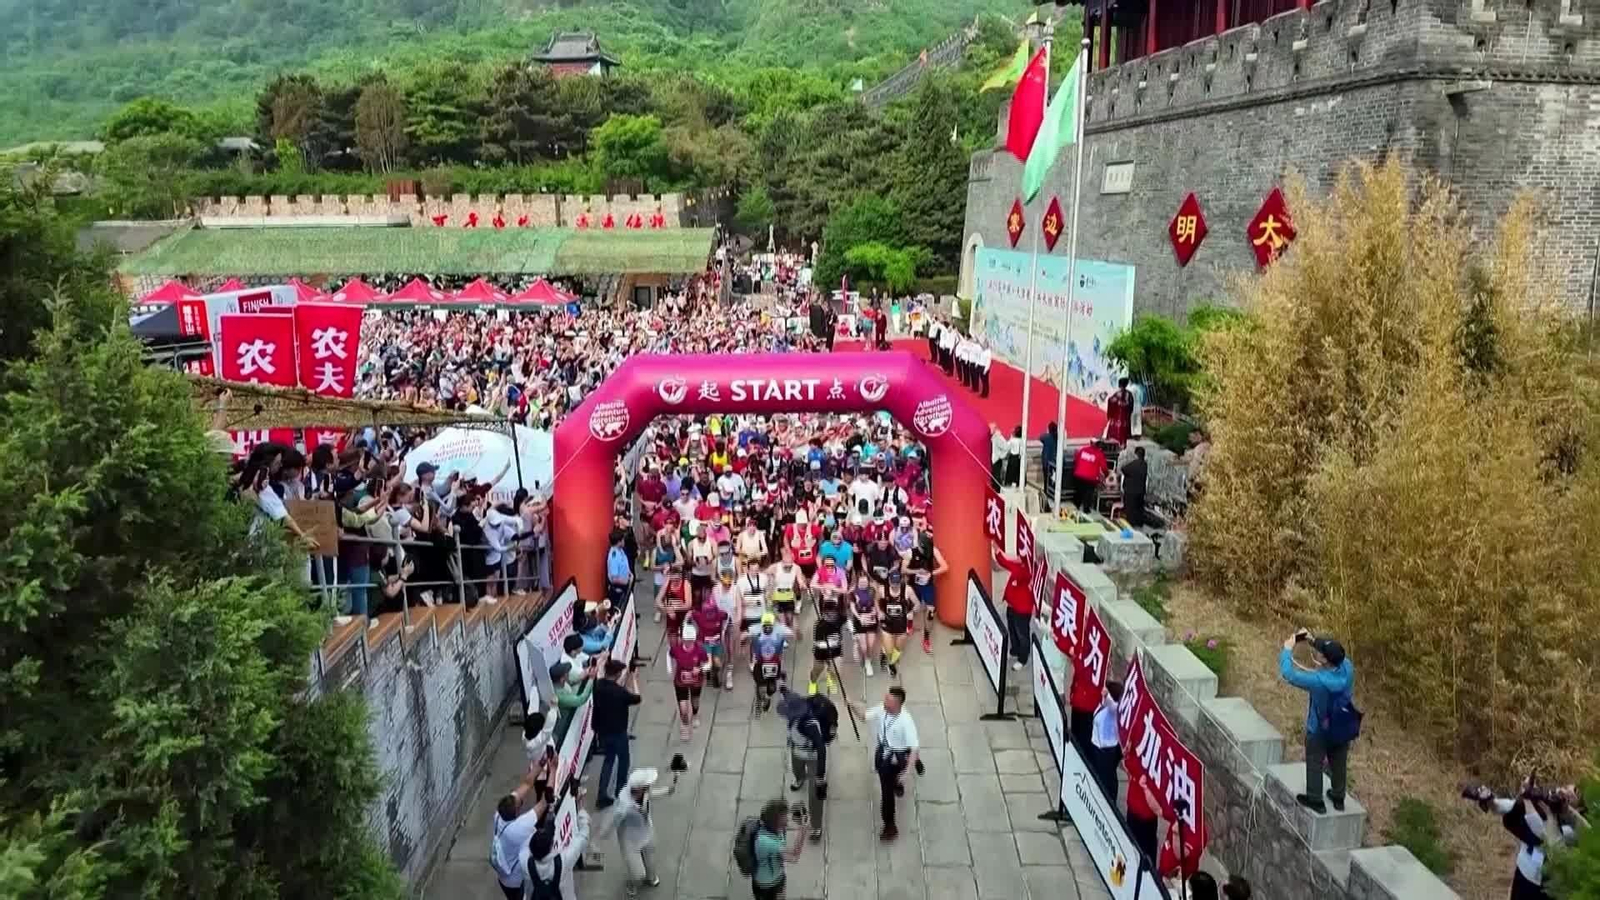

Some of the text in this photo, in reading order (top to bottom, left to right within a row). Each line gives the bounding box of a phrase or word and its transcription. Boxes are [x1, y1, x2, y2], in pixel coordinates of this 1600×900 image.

[1044, 212, 1058, 236] 边
[1176, 215, 1198, 245] 明
[1253, 214, 1285, 249] 大
[242, 297, 269, 313] FINISH
[697, 376, 847, 402] 起 START 点
[548, 615, 564, 642] STEP
[985, 498, 1002, 540] 农
[1054, 587, 1079, 644] 泉
[1083, 625, 1104, 687] 为
[1135, 707, 1196, 835] 加油
[559, 810, 572, 843] UP
